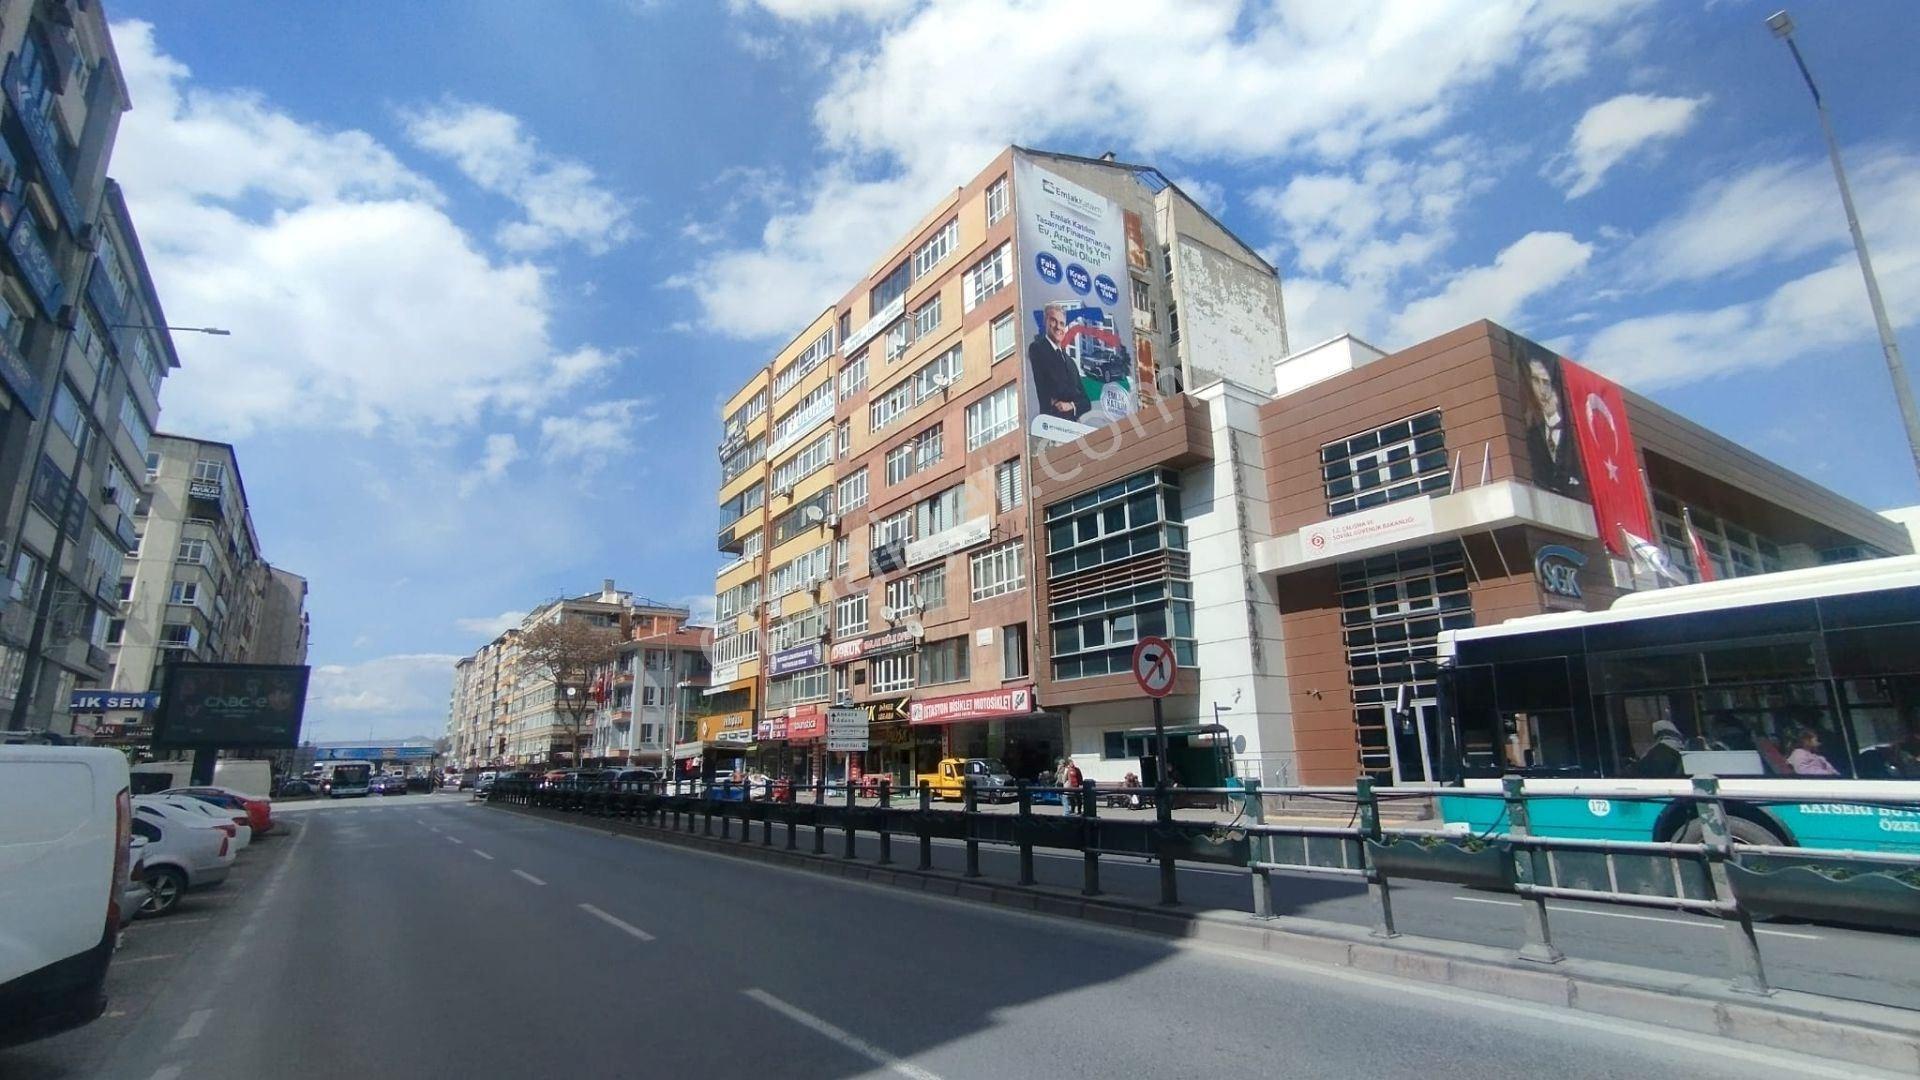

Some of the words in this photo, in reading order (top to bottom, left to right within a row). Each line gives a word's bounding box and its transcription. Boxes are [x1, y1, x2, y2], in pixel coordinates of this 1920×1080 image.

[1041, 258, 1057, 271] Faiz
[1041, 266, 1057, 279] Yok
[1072, 278, 1086, 289] Yok
[1100, 288, 1114, 300] Yok
[1542, 562, 1582, 599] SGK
[107, 697, 146, 708] SEN
[973, 693, 1012, 711] MOTOSİKLET
[1591, 800, 1608, 812] 172
